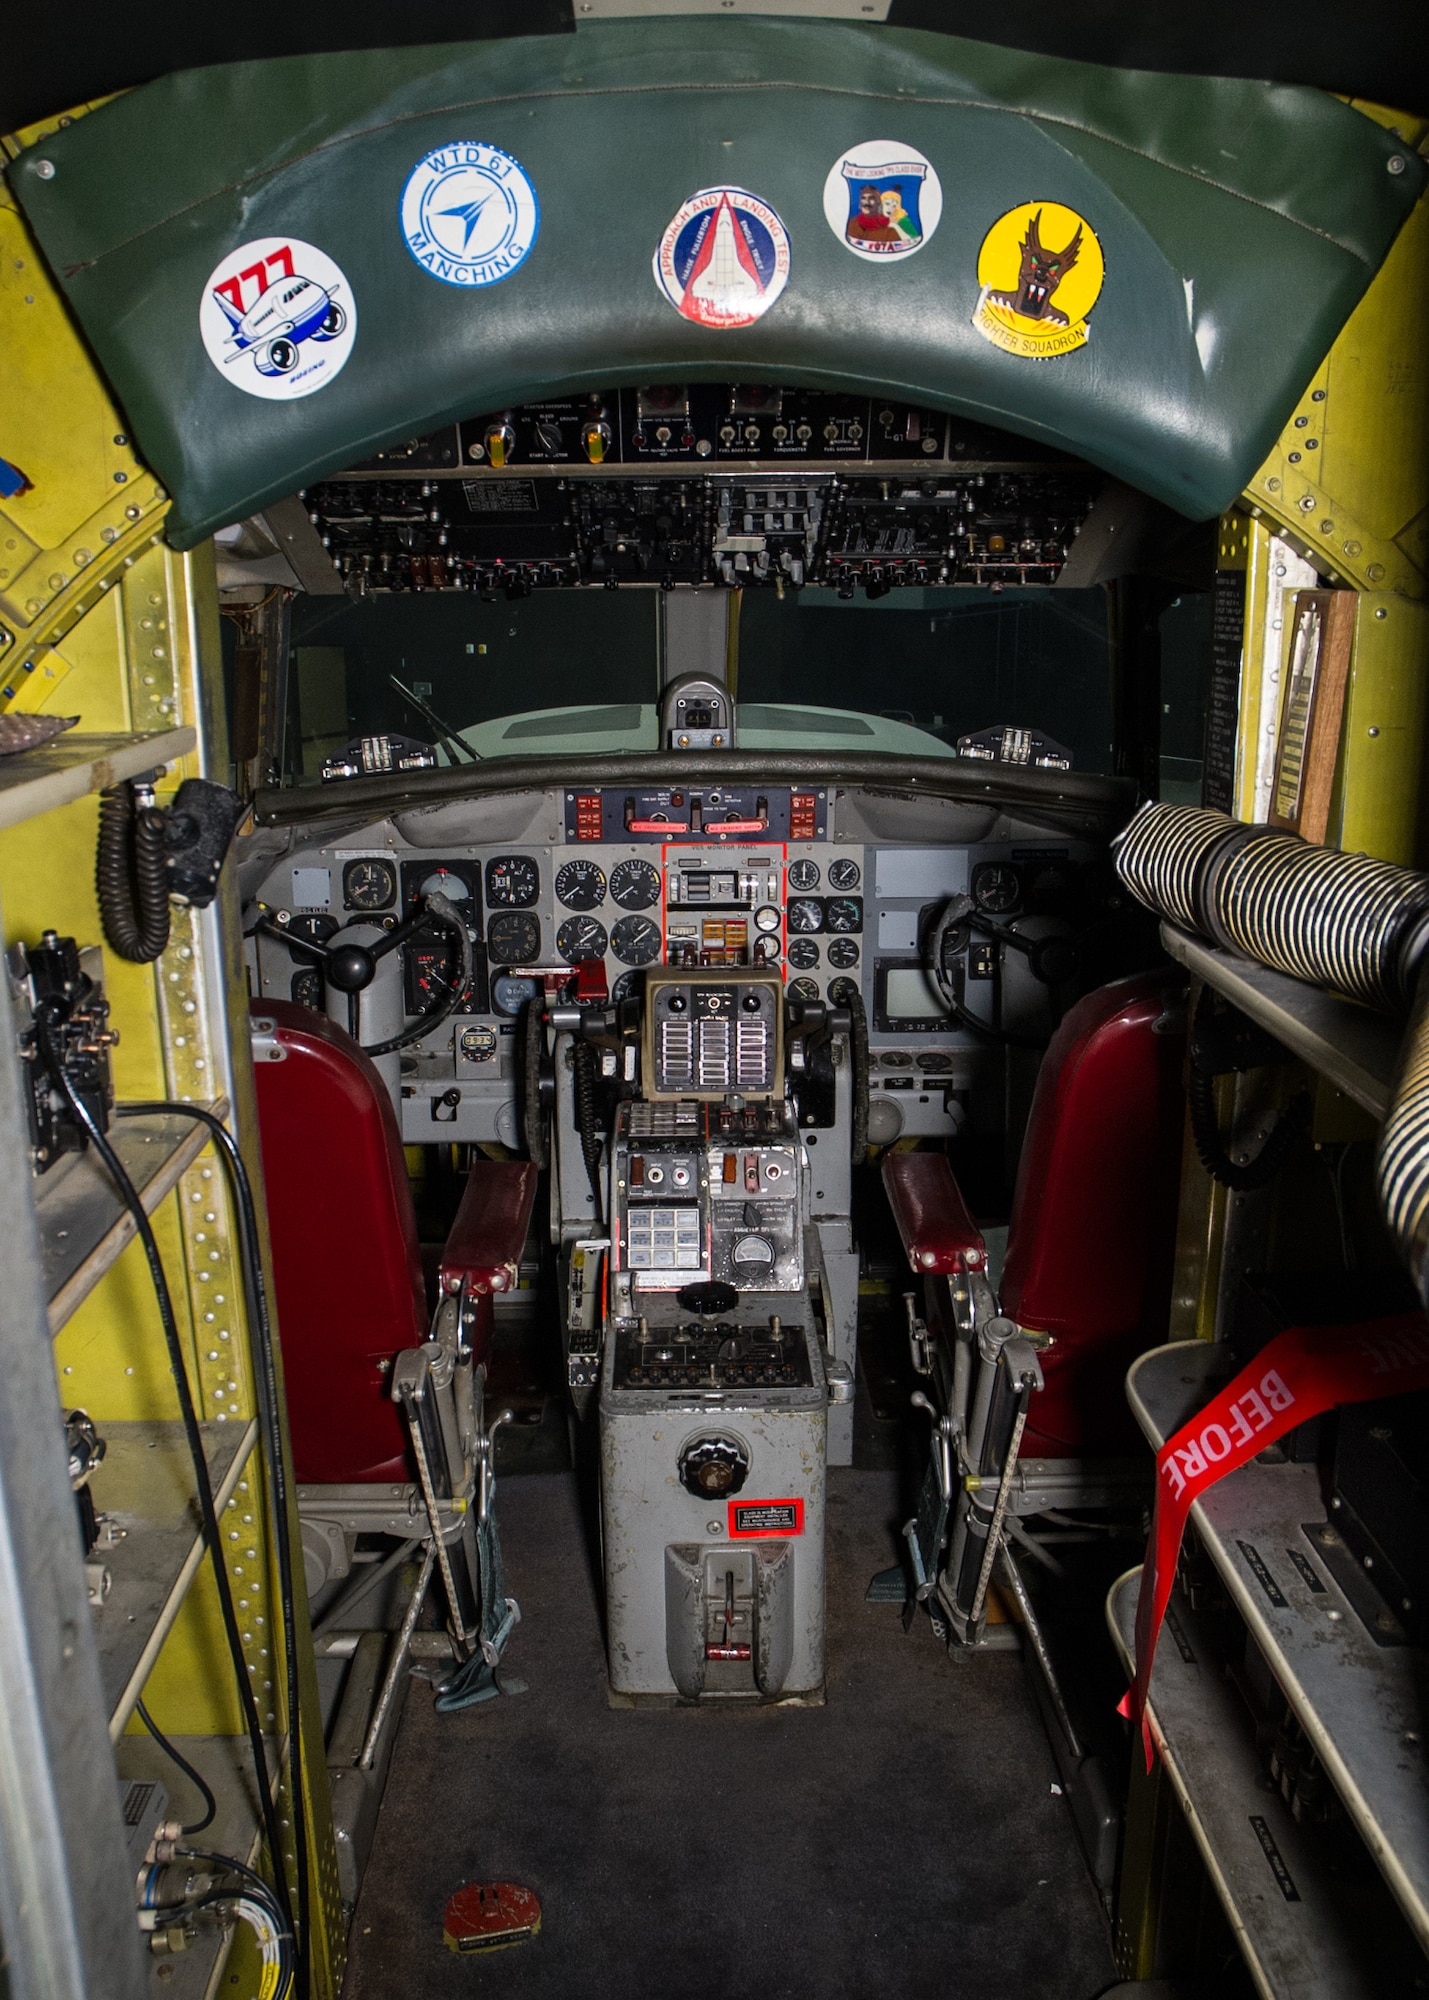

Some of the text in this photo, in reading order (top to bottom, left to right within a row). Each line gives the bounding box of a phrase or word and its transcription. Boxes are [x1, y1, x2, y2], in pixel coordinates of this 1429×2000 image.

[427, 147, 513, 178] WTD 61
[408, 230, 526, 284] MANCHING
[661, 195, 788, 277] APPROACH AND LANDING TEST
[740, 219, 755, 244] ENGLE
[212, 244, 297, 313] 777
[979, 309, 1085, 353] FIGHTER SQUADRON
[1161, 1368, 1296, 1501] BEFORE
